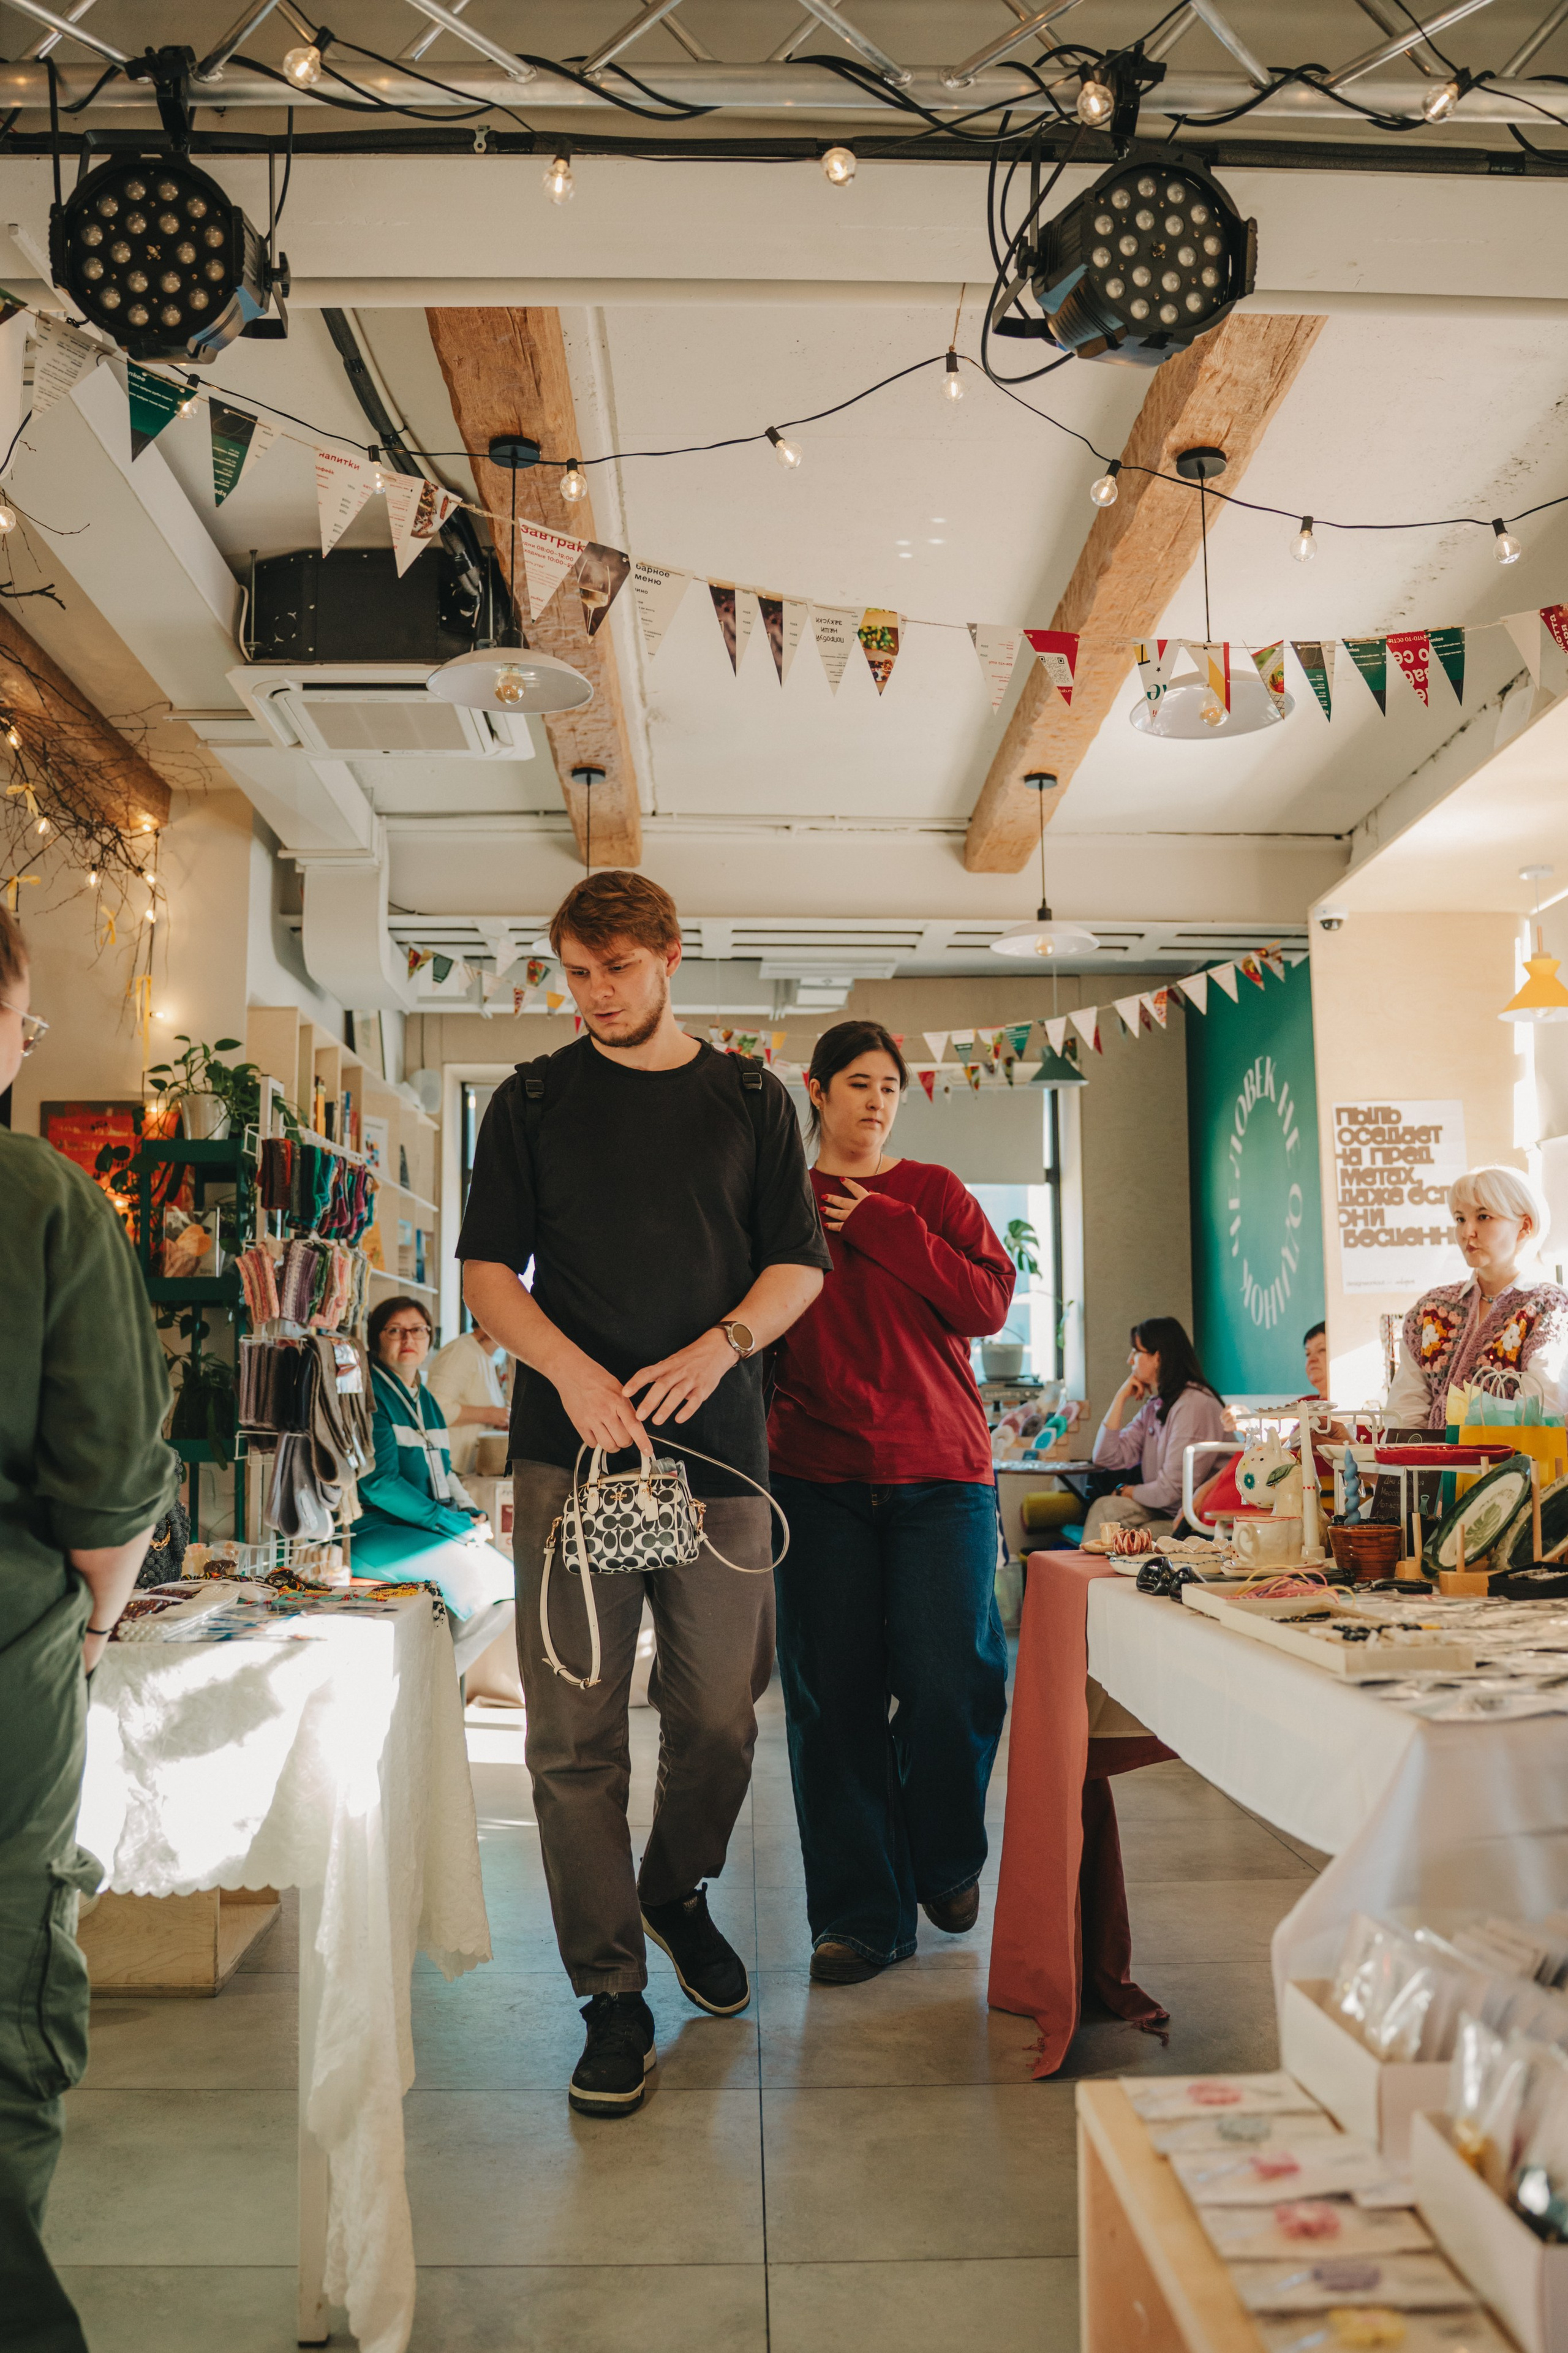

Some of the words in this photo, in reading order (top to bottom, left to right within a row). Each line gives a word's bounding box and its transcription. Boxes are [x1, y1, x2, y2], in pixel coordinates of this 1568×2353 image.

[318, 453, 360, 471] напитки
[521, 524, 587, 553] завтрак
[635, 573, 662, 586] меню
[636, 563, 670, 578] барное
[1408, 1185, 1450, 1205] есл
[1343, 1226, 1457, 1248] бесценн
